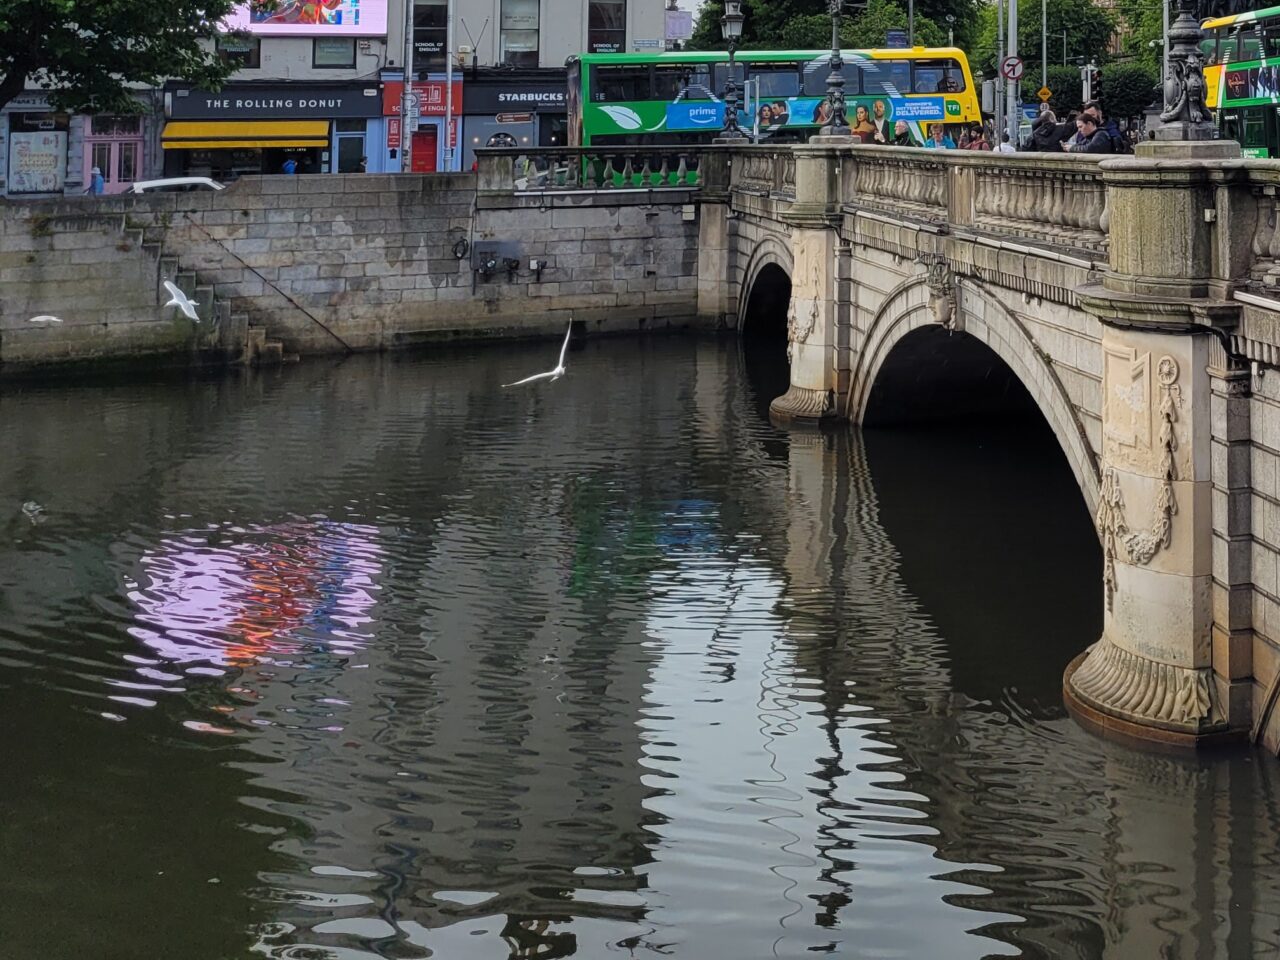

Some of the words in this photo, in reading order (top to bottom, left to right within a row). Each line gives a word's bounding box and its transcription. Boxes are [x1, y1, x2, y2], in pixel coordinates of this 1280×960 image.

[498, 93, 563, 101] STARBUCKS
[206, 99, 230, 108] THE
[236, 99, 293, 108] ROLLING
[299, 99, 343, 108] DONUT
[689, 107, 716, 117] prime
